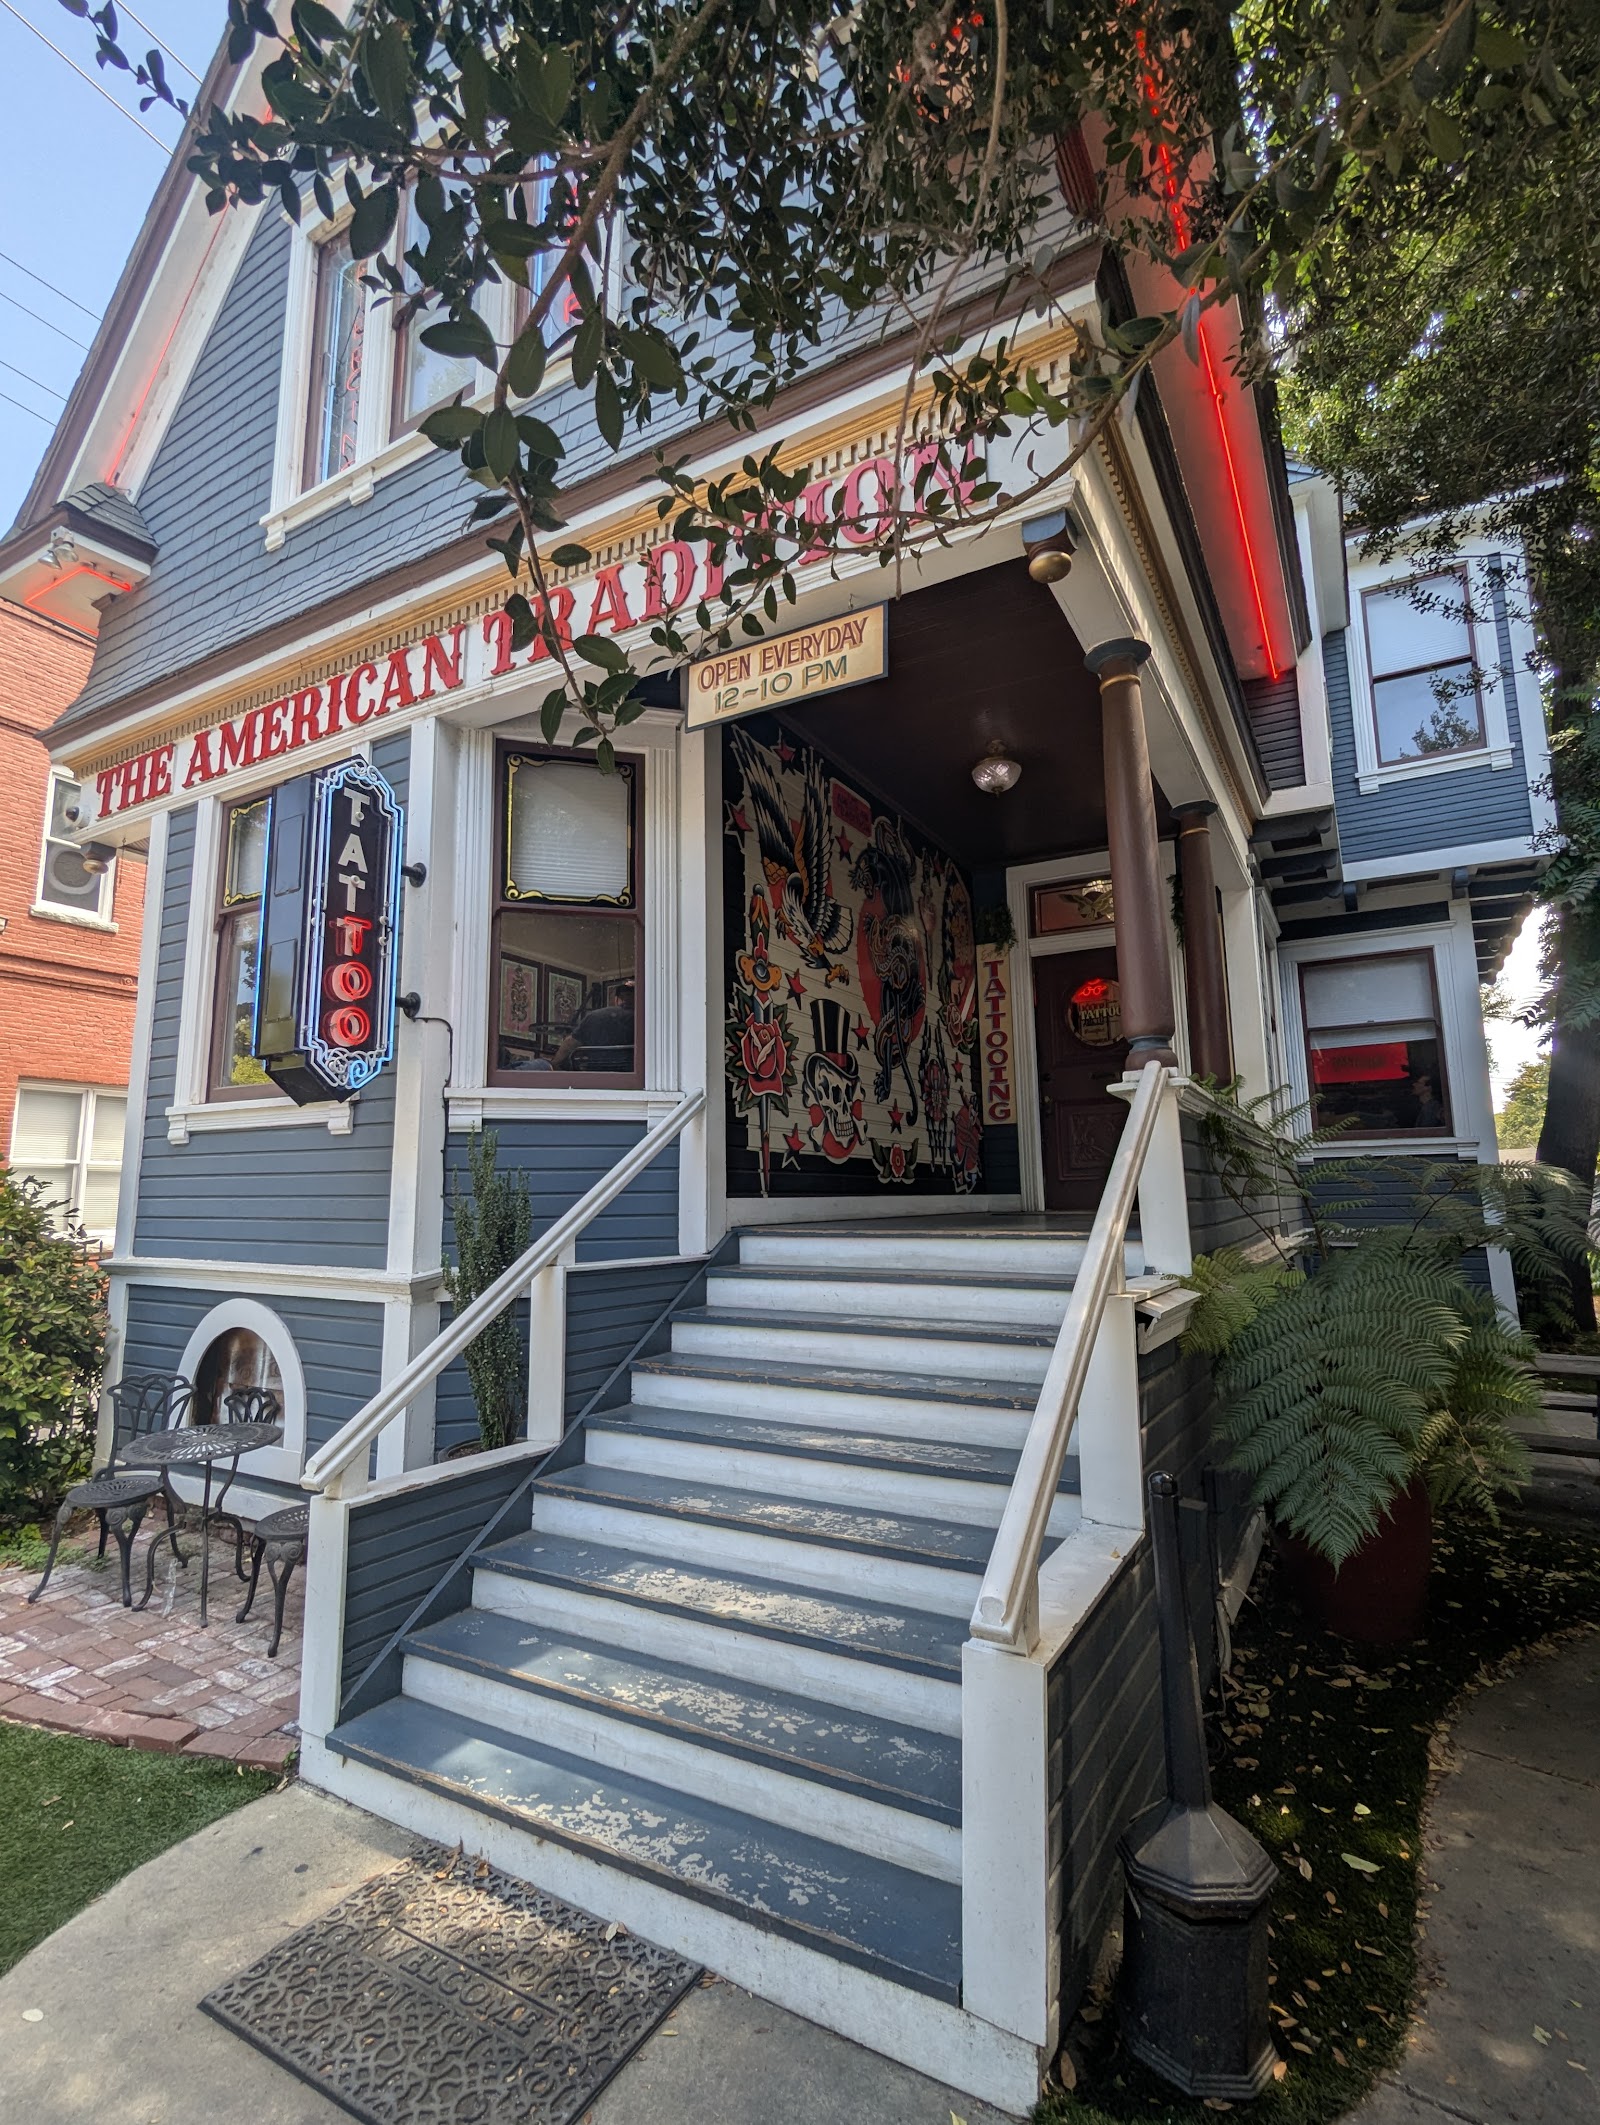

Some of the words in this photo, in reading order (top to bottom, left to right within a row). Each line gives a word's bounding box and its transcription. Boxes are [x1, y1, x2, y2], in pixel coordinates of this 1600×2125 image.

[96, 743, 175, 818] THE
[182, 623, 467, 788] AMERICAN
[699, 652, 752, 692] OPEN
[759, 616, 869, 676] EVERYDAY
[803, 654, 849, 689] PM
[324, 786, 373, 1047] TATTOO
[983, 959, 1011, 1121] TATTOOING
[377, 1930, 544, 2037] WELCOME
